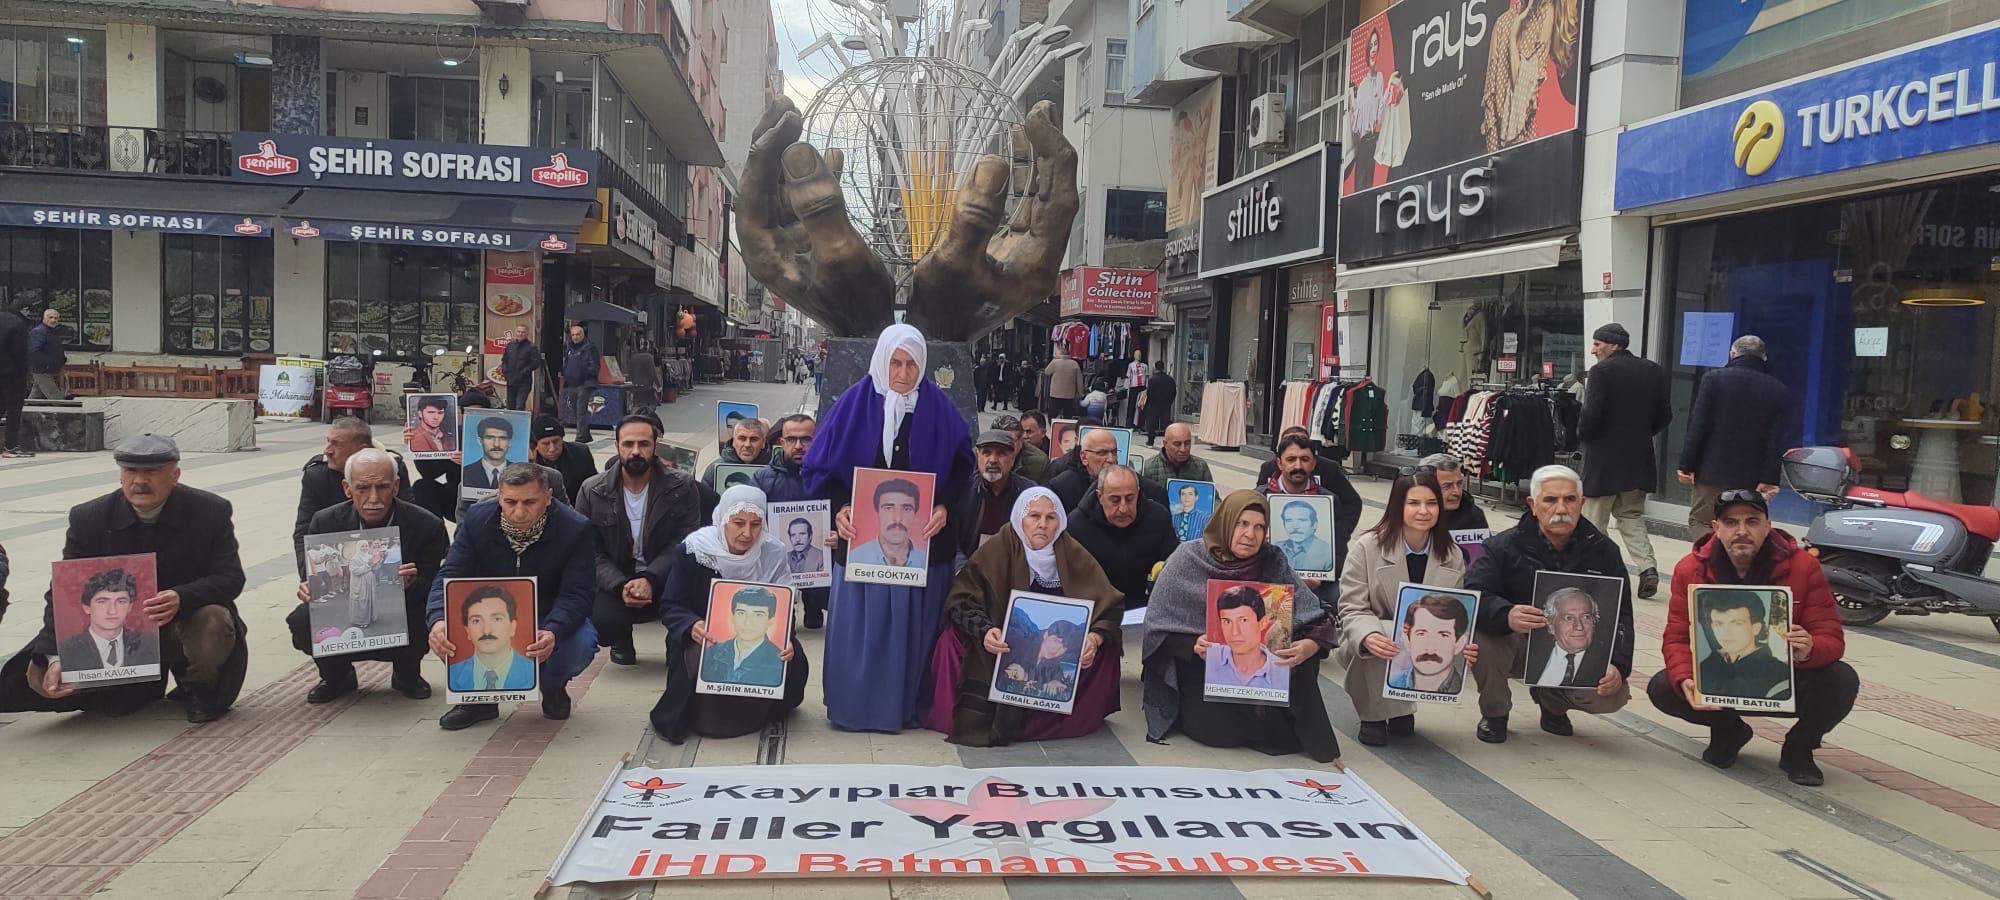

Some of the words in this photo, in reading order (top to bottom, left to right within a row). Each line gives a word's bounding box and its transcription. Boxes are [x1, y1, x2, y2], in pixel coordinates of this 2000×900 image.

[1410, 0, 1487, 74] rays
[1797, 62, 2000, 147] TURKCELL
[246, 157, 292, 173] şenpiliç
[308, 142, 393, 180] ŞEHİR
[402, 151, 521, 183] SOFRASI
[538, 169, 582, 184] şenpiliç
[1376, 167, 1485, 237] rays
[32, 209, 101, 225] ŞEHİR
[108, 213, 203, 230] SOFRASI
[1227, 181, 1280, 242] stilife
[350, 225, 415, 241] ŞEHİR
[421, 229, 512, 246] SOFRASI
[1097, 271, 1144, 288] Şirin
[1087, 286, 1152, 299] Collection
[1292, 278, 1318, 300] stilife
[773, 504, 805, 514] İBRAHİM
[806, 503, 829, 513] ÇELİK
[1454, 533, 1485, 543] ÇELİK
[854, 568, 875, 578] Eset
[877, 568, 919, 581] GÖKTAYI
[321, 640, 367, 653] MERYEM
[369, 635, 403, 647] BULUT
[104, 668, 137, 678] KAVAK
[706, 684, 741, 693] M.ŞİRİN
[743, 687, 775, 696] MALTU
[1205, 685, 1236, 695] MEHMET
[1254, 690, 1287, 699] AKYILDIZ
[1388, 689, 1418, 699] Medeni
[1001, 693, 1031, 705] İSMAİL
[1705, 696, 1739, 705] FEHMİ
[1742, 699, 1781, 709] BATUR
[703, 782, 966, 804] Kayıplar
[986, 782, 1283, 799] Bulunsun
[591, 814, 885, 840] Failler
[908, 813, 1420, 844] Yargılansın
[627, 849, 767, 876] İHD
[797, 852, 1088, 874] Batman
